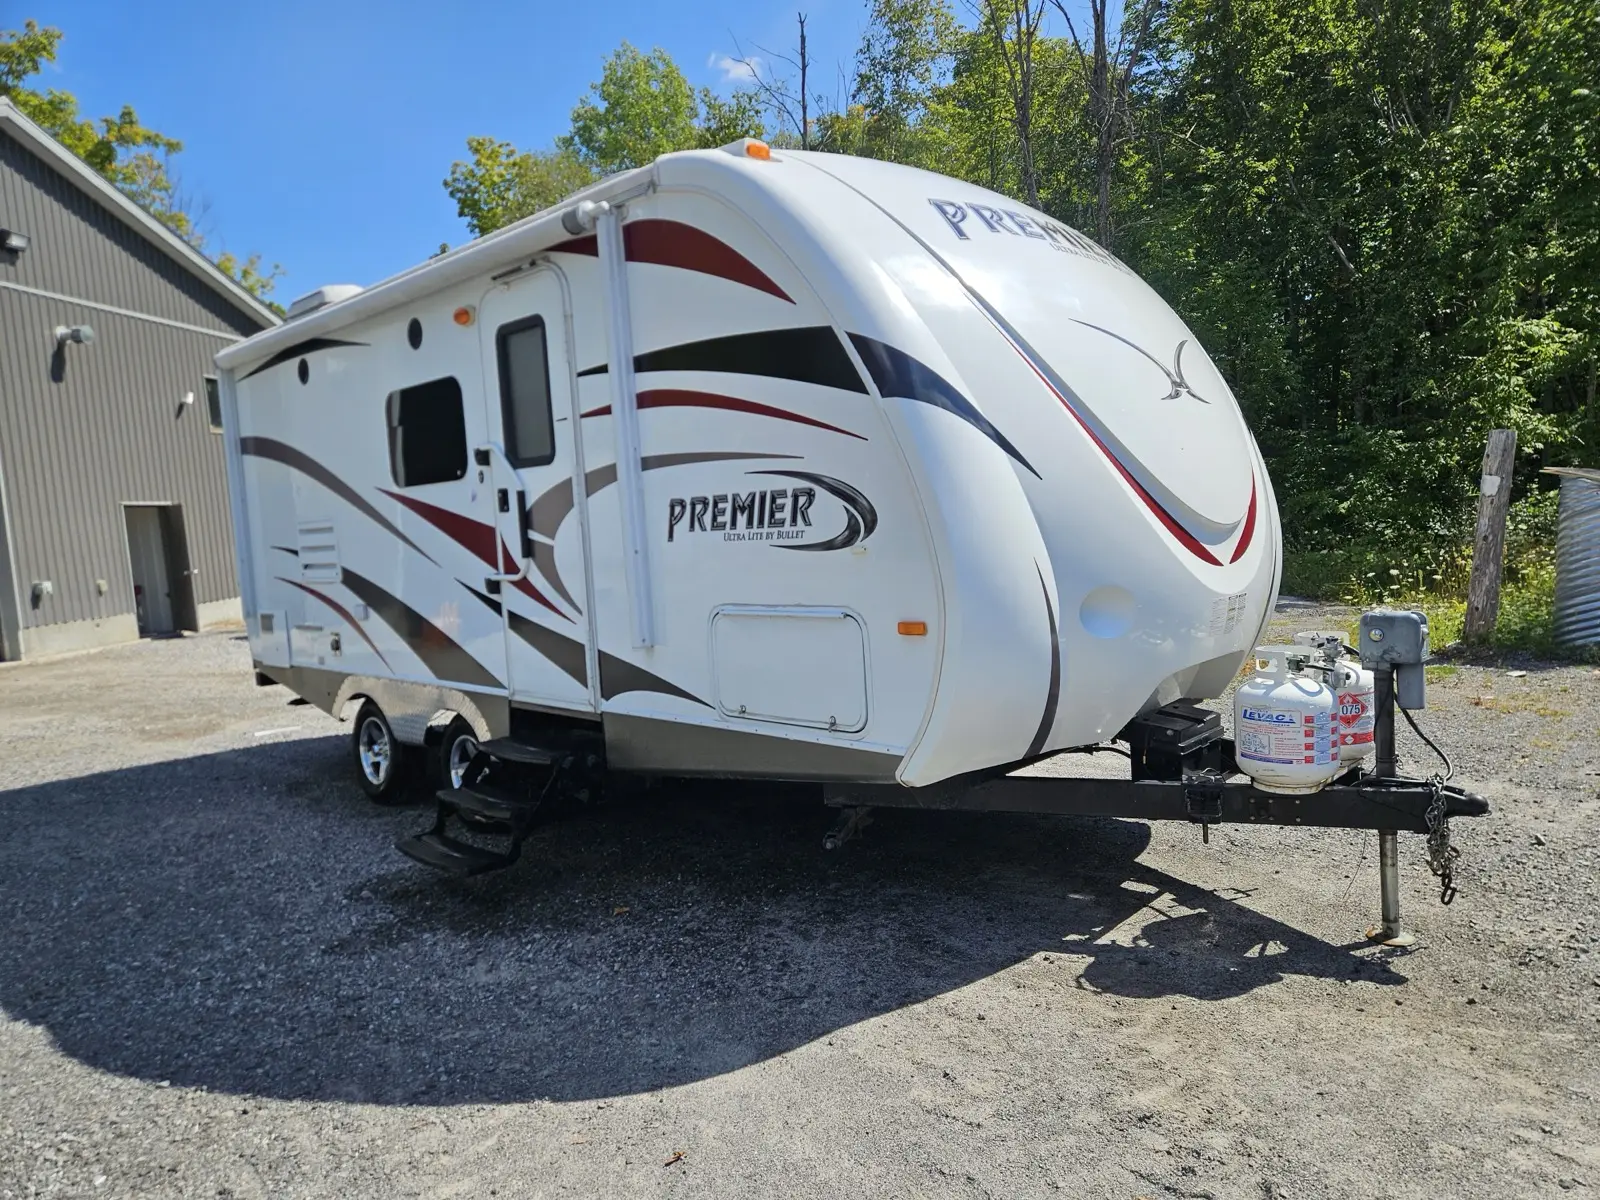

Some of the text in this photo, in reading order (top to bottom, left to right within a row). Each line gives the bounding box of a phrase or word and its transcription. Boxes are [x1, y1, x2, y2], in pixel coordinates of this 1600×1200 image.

[668, 487, 816, 543] PREMIER
[1242, 708, 1287, 722] LEVAC
[1341, 704, 1360, 715] 075
